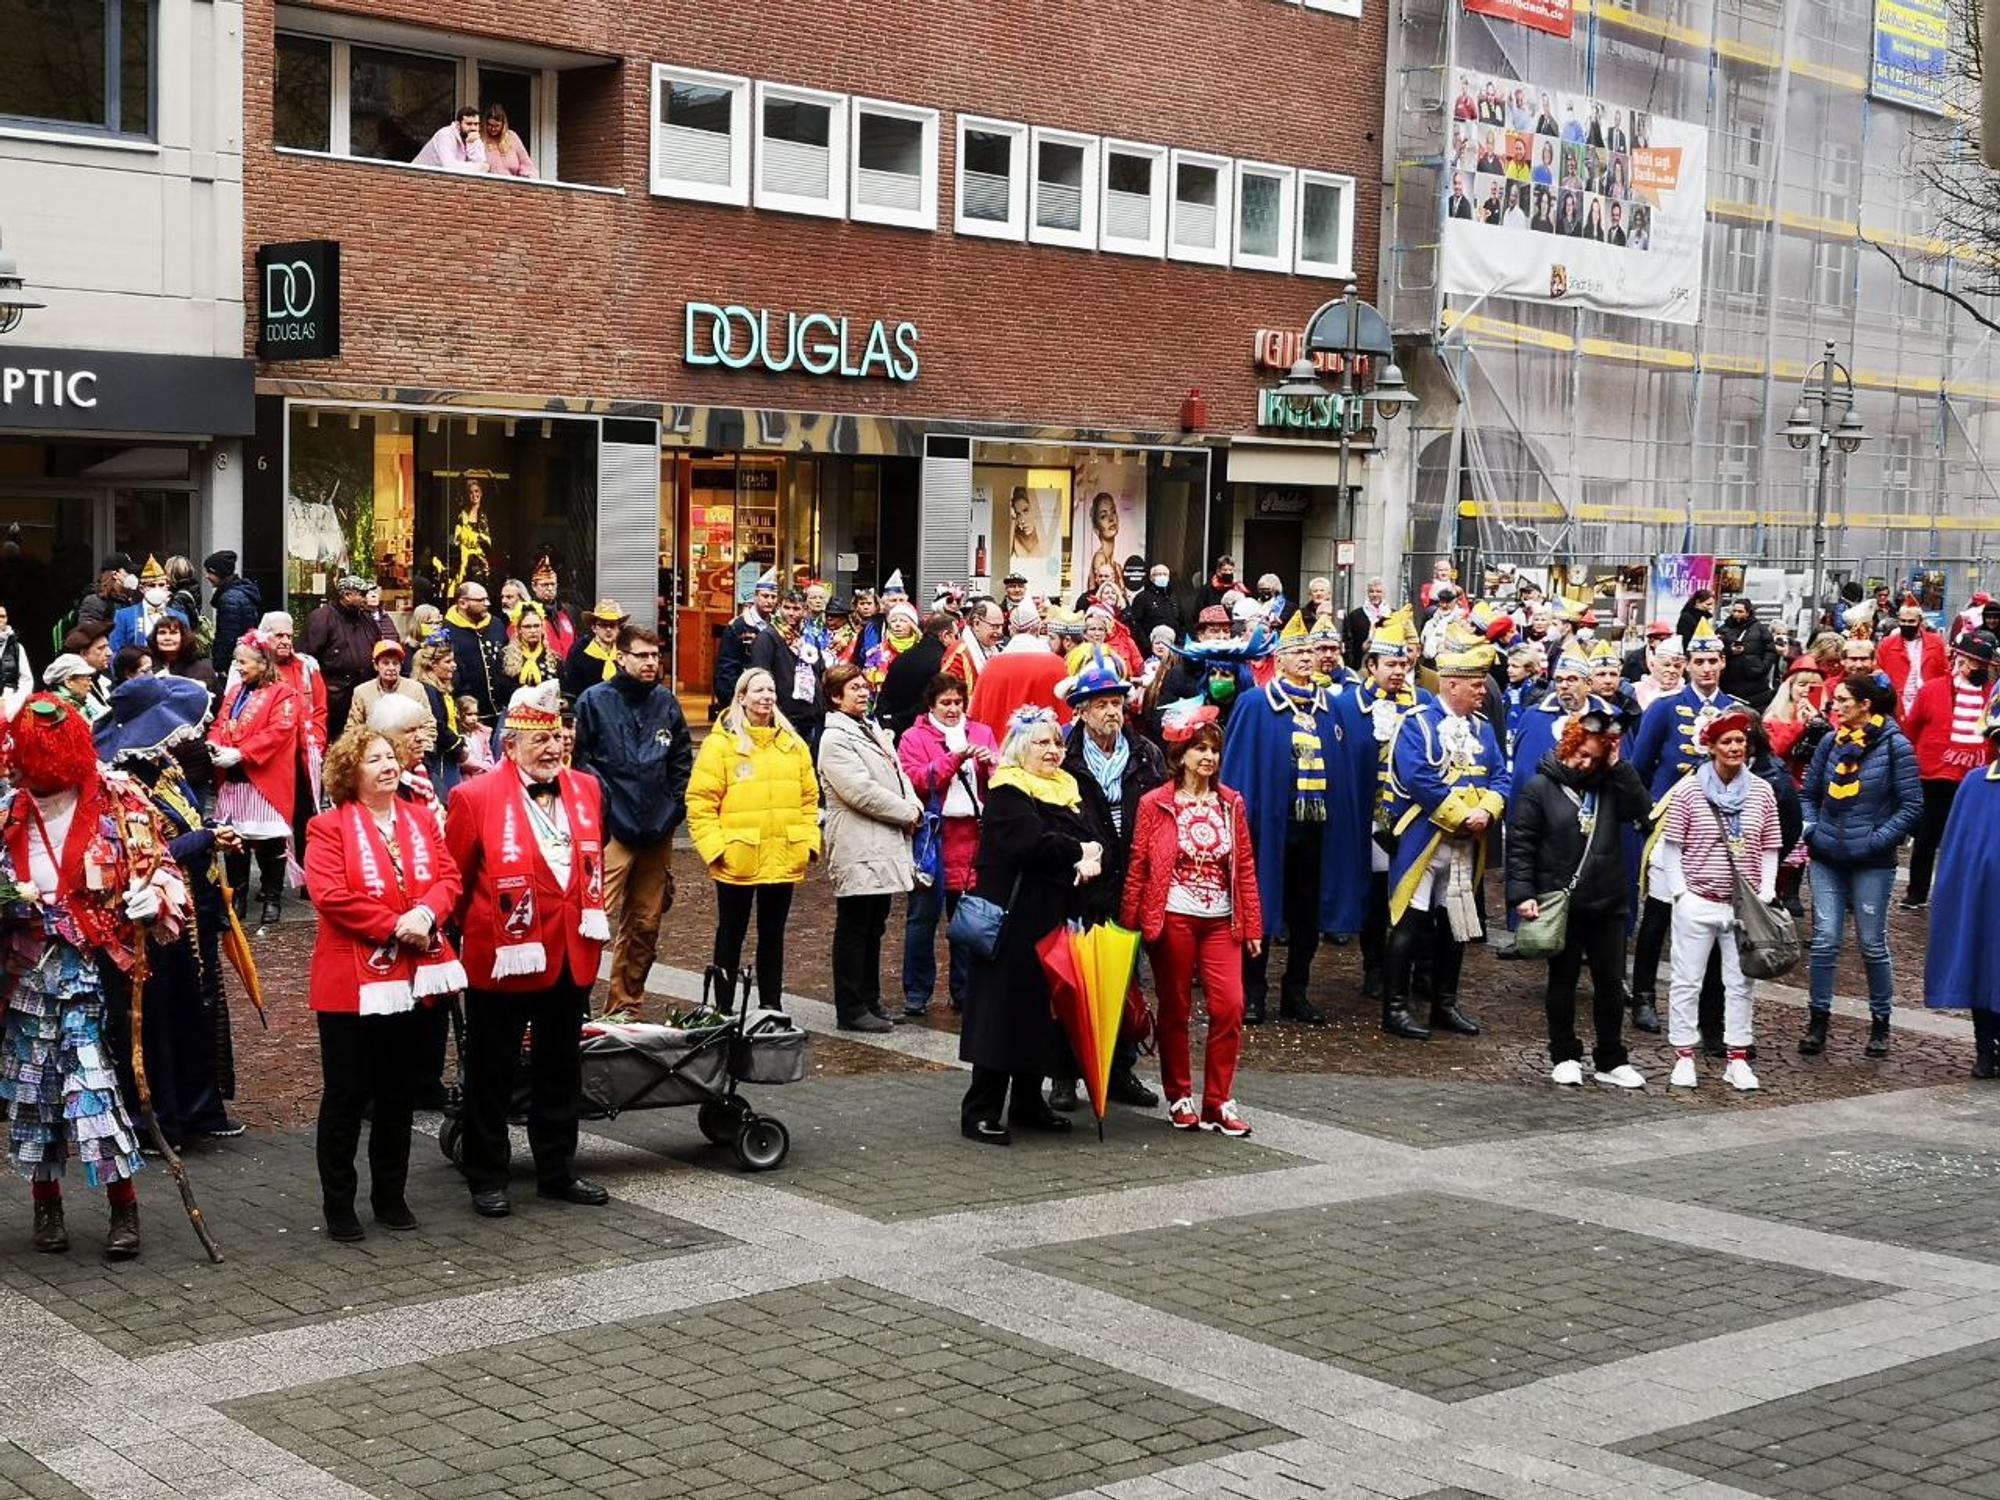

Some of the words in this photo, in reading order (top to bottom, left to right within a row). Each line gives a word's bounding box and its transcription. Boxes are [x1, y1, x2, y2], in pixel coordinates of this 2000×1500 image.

[266, 321, 316, 342] DOUGLAS
[684, 301, 920, 381] DOUGLAS
[216, 453, 229, 470] 8
[257, 455, 268, 471] 6
